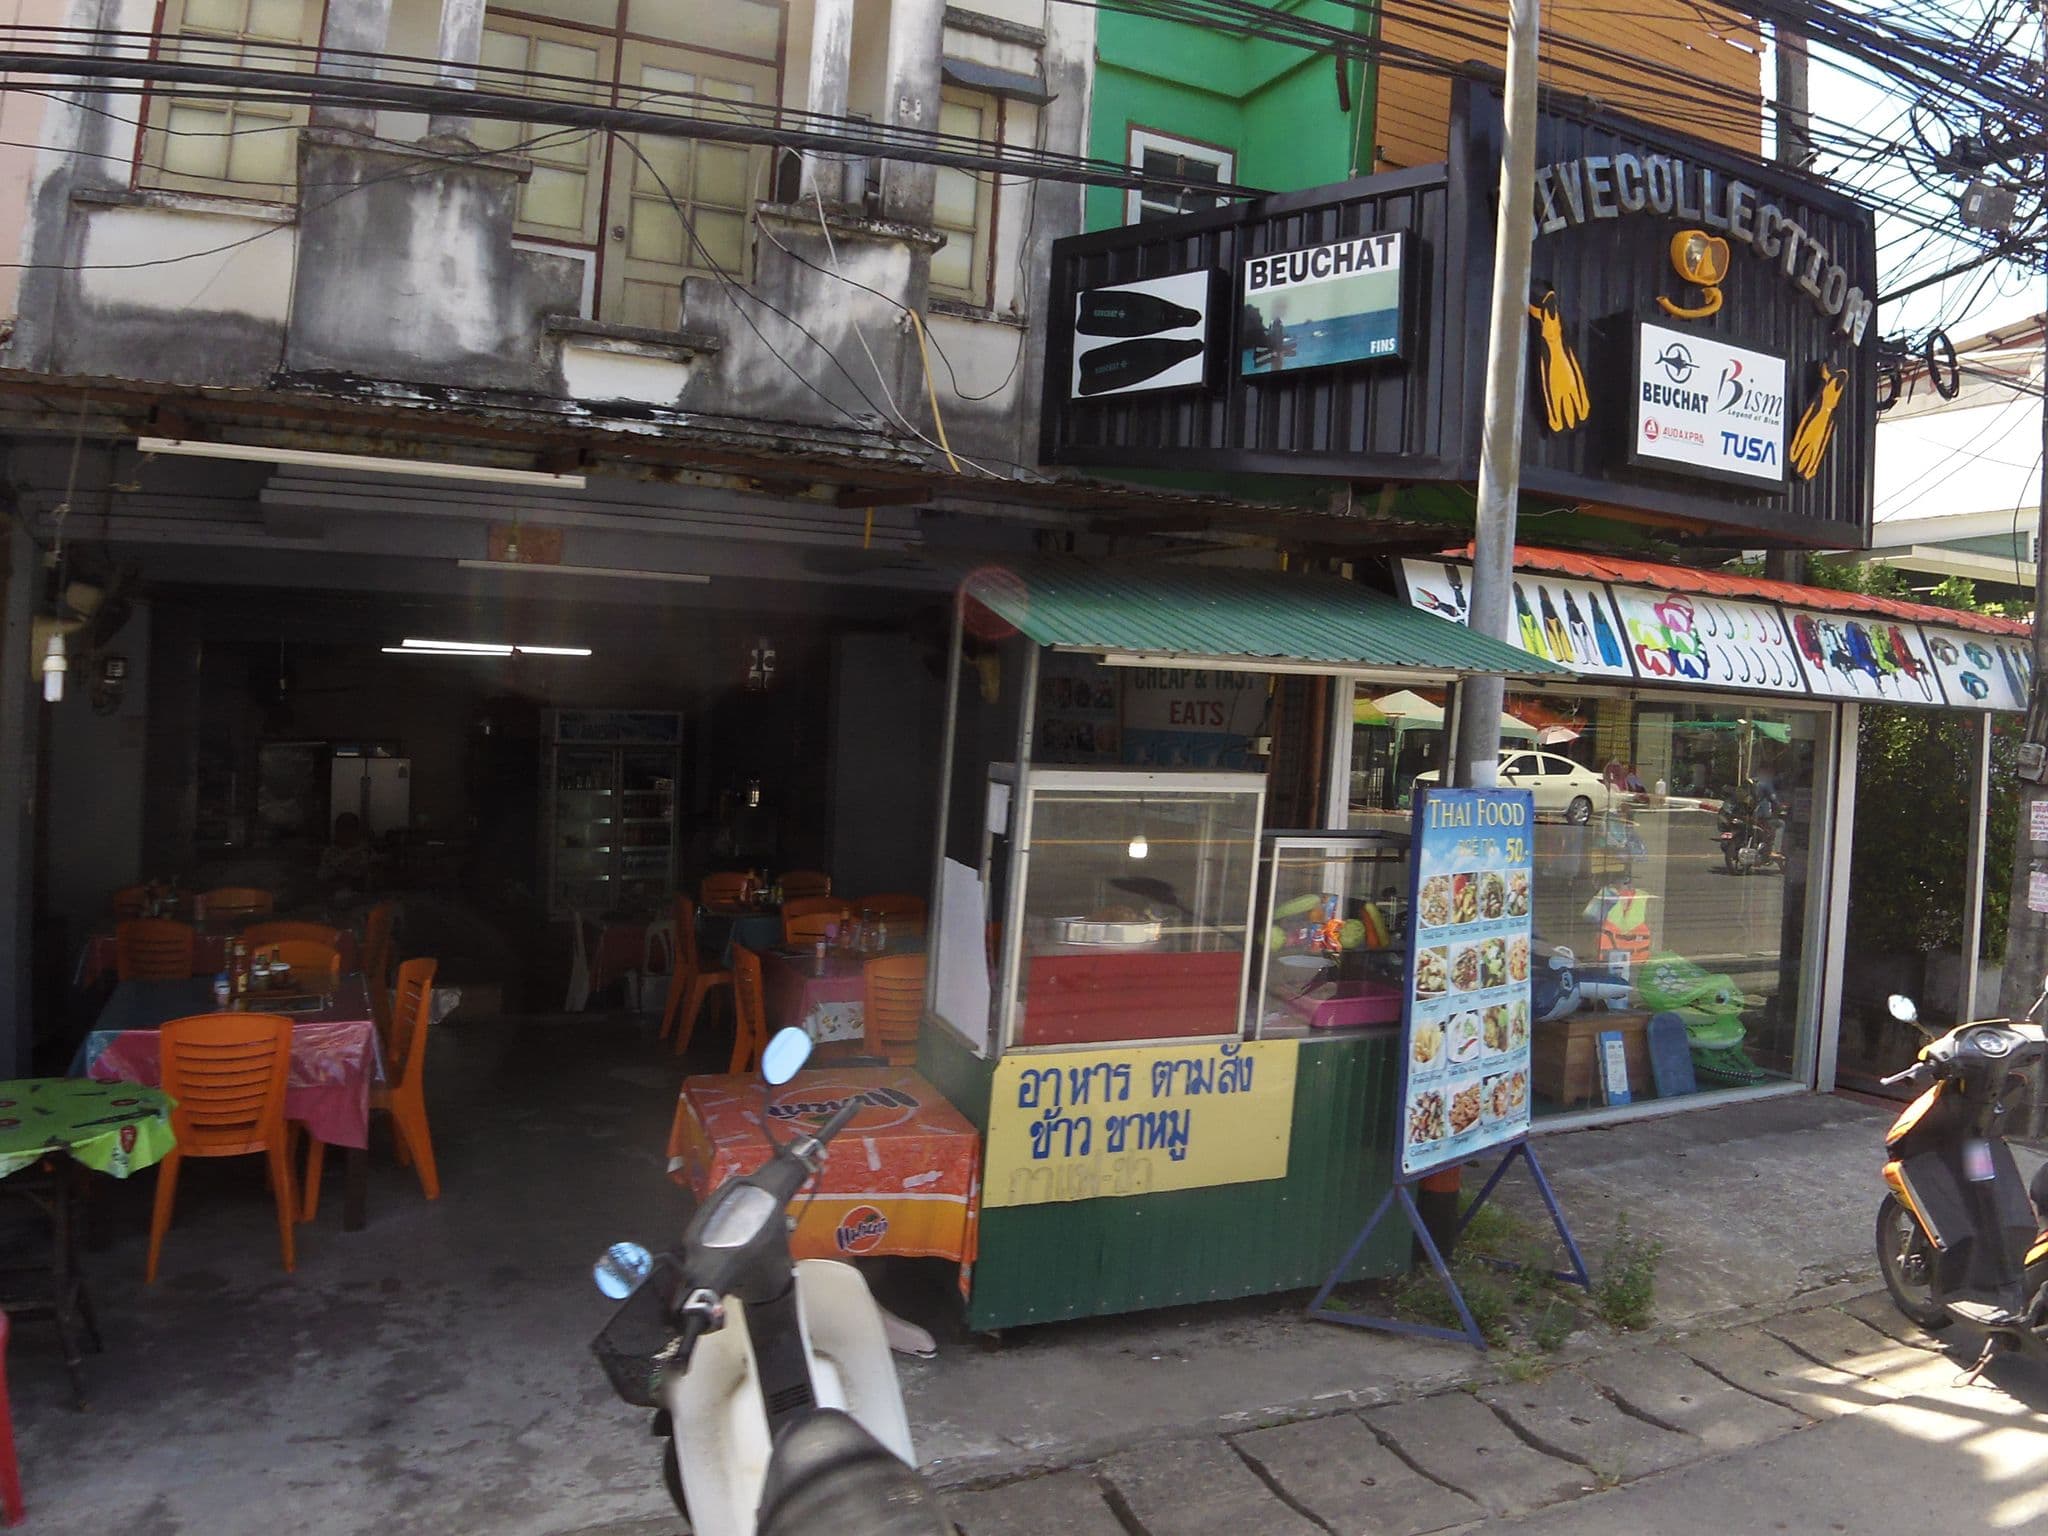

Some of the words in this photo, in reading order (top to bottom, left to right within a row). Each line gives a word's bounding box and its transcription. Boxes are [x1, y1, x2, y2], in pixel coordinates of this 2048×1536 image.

[1250, 235, 1396, 290] BEUCHAT
[1532, 153, 1873, 348] IVECOLLECTION
[1370, 338, 1396, 354] FINS
[1643, 381, 1710, 415] BEUCHAT
[1717, 358, 1783, 417] Bism
[1727, 408, 1753, 420] Legend
[1720, 430, 1777, 466] TUSA
[1169, 700, 1225, 726] EATS
[1017, 1062, 1132, 1109] อาหาร
[1030, 1106, 1092, 1160] ข้าว
[1105, 1108, 1192, 1162] ขาหมู
